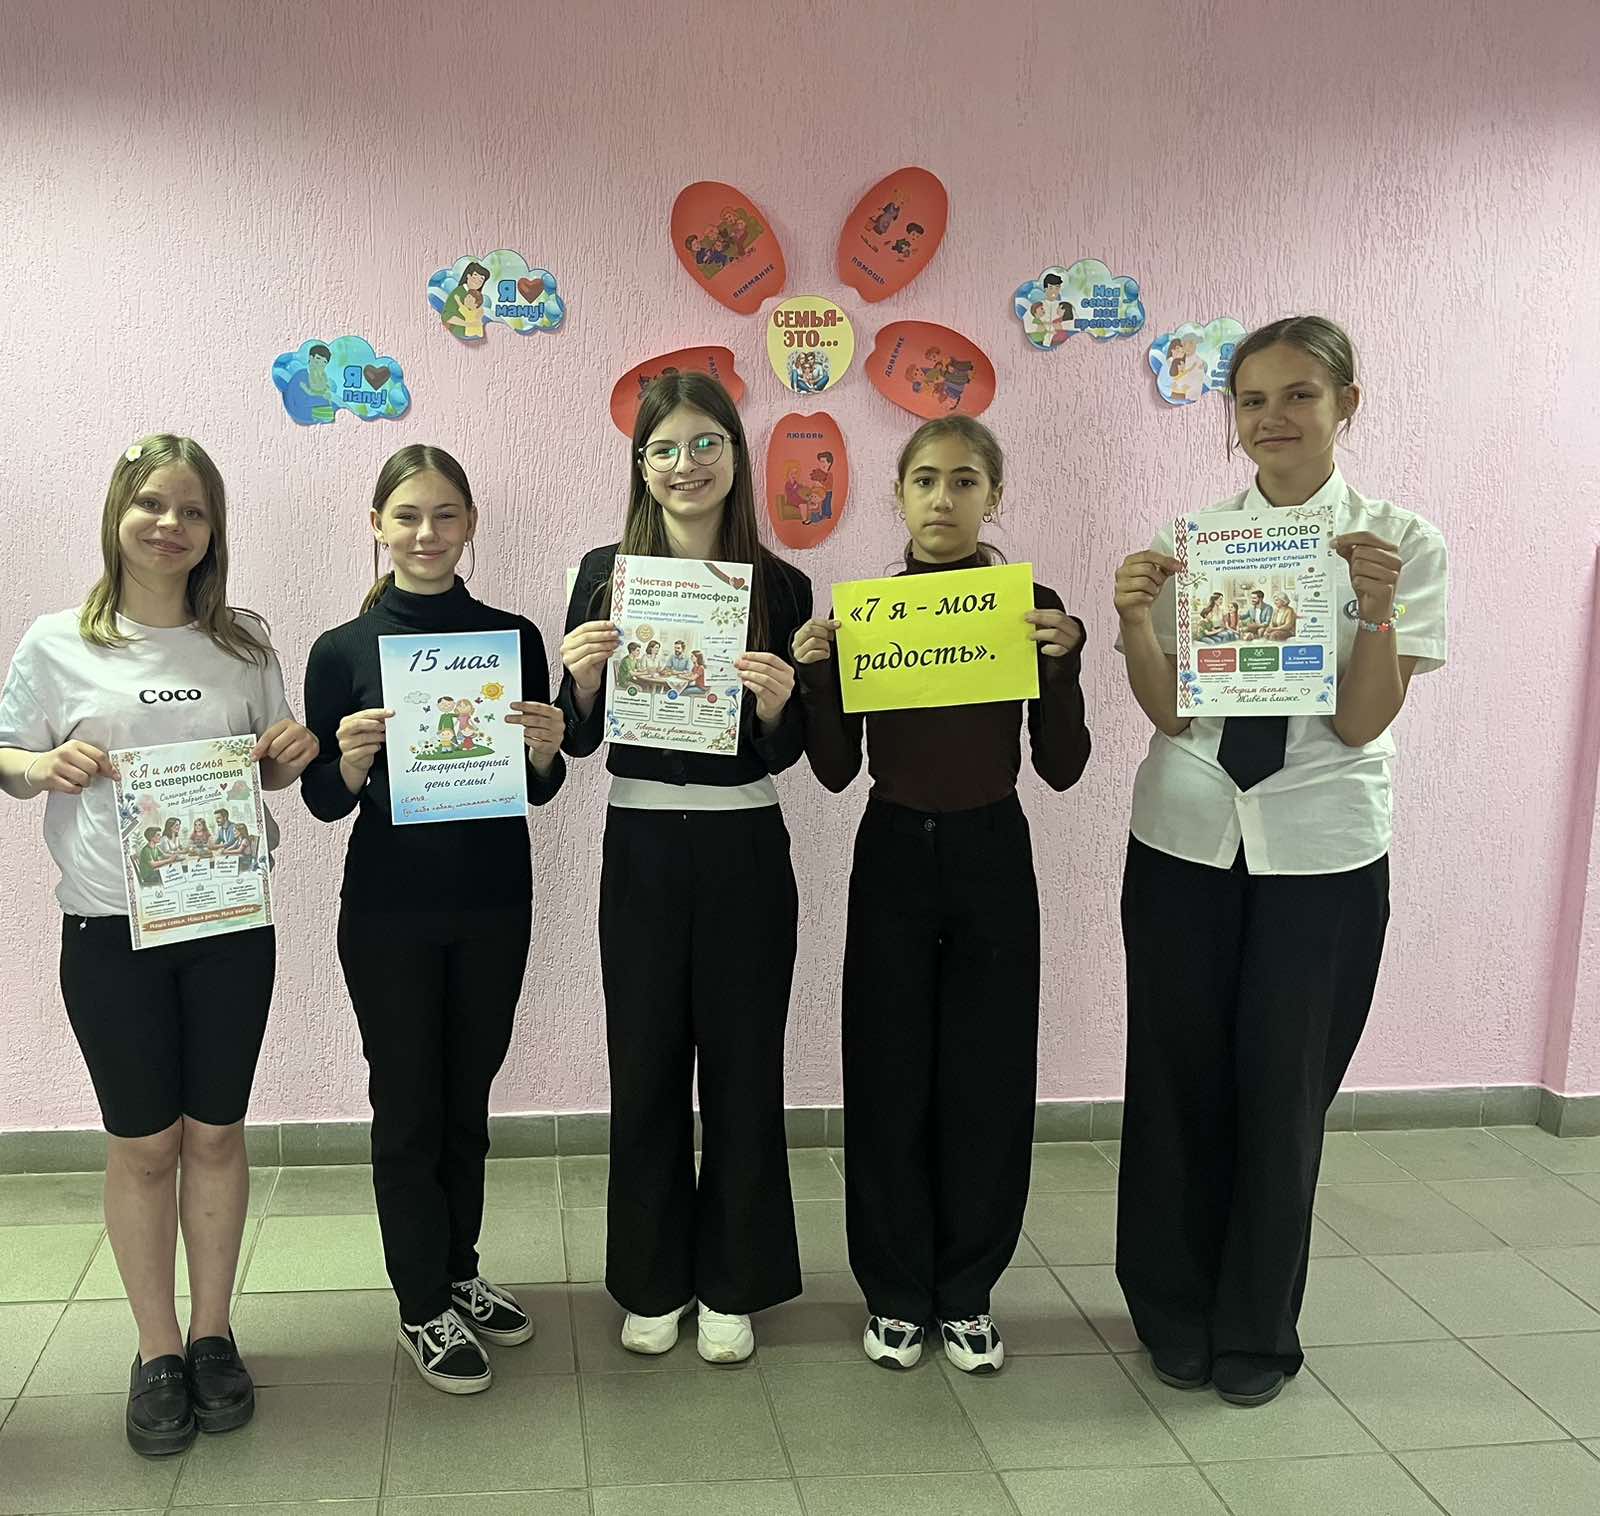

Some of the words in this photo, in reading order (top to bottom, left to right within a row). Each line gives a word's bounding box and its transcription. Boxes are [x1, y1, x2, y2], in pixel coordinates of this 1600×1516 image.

[851, 256, 886, 285] ПОМОЩЬ
[732, 263, 775, 298] ВНИМАНИЕ
[497, 279, 516, 303] Я
[1093, 285, 1120, 297] Моя
[496, 302, 545, 321] маму!
[773, 309, 844, 328] СЕМЬЯ-
[1093, 309, 1118, 318] моя
[784, 330, 838, 348] ЭТО...
[884, 336, 905, 377] ДОВЕРИЕ
[343, 365, 362, 388] Я
[343, 389, 387, 408] папу!
[786, 432, 824, 440] ЛЮБОВЬ
[1196, 528, 1263, 545] ДОБРОЕ
[1266, 524, 1320, 538] СЛОВО
[1225, 538, 1321, 554] СБЛИЖАЕТ
[1246, 556, 1280, 564] помогает
[630, 577, 672, 587] «Чистая
[675, 580, 700, 590] речь
[628, 598, 661, 607] дома»
[629, 588, 679, 598] здоровая
[681, 592, 739, 604] атмосфера
[850, 597, 881, 623] «7
[888, 601, 908, 621] я
[935, 592, 998, 616] моя
[409, 648, 441, 672] 15
[444, 654, 500, 671] мая
[852, 641, 996, 681] радость».
[138, 688, 202, 704] Coco
[1221, 686, 1257, 695] Говорим
[129, 763, 149, 778] «Я
[164, 764, 186, 775] моя
[190, 758, 223, 771] семья
[406, 755, 511, 774] Международный
[131, 779, 152, 791] без
[154, 768, 244, 787] сквернословия
[424, 779, 451, 792] день
[453, 772, 495, 787] семьи!
[205, 789, 222, 799] слова
